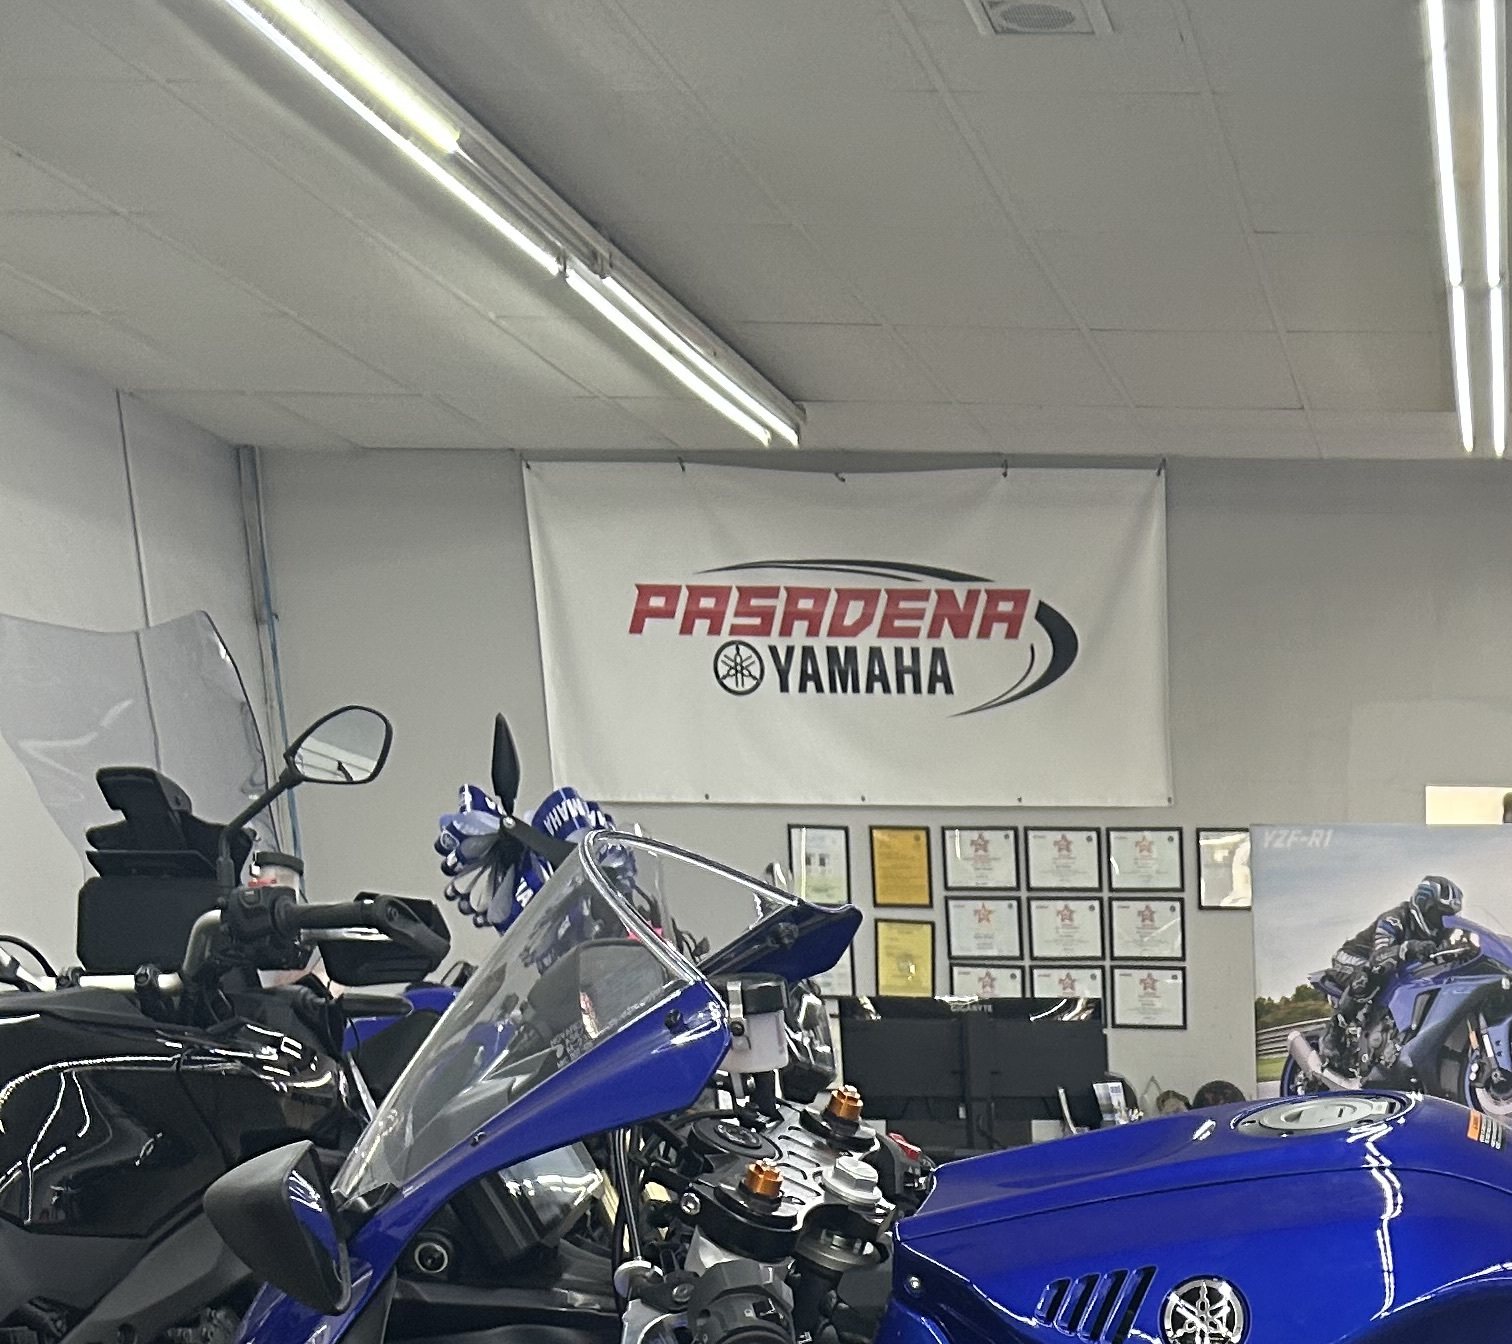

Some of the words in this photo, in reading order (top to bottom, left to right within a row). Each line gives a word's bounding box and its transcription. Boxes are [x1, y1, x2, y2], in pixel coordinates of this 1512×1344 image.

[629, 583, 1031, 641] PASADENA
[768, 644, 954, 695] YAMAHA
[1263, 828, 1334, 849] YZF-R1
